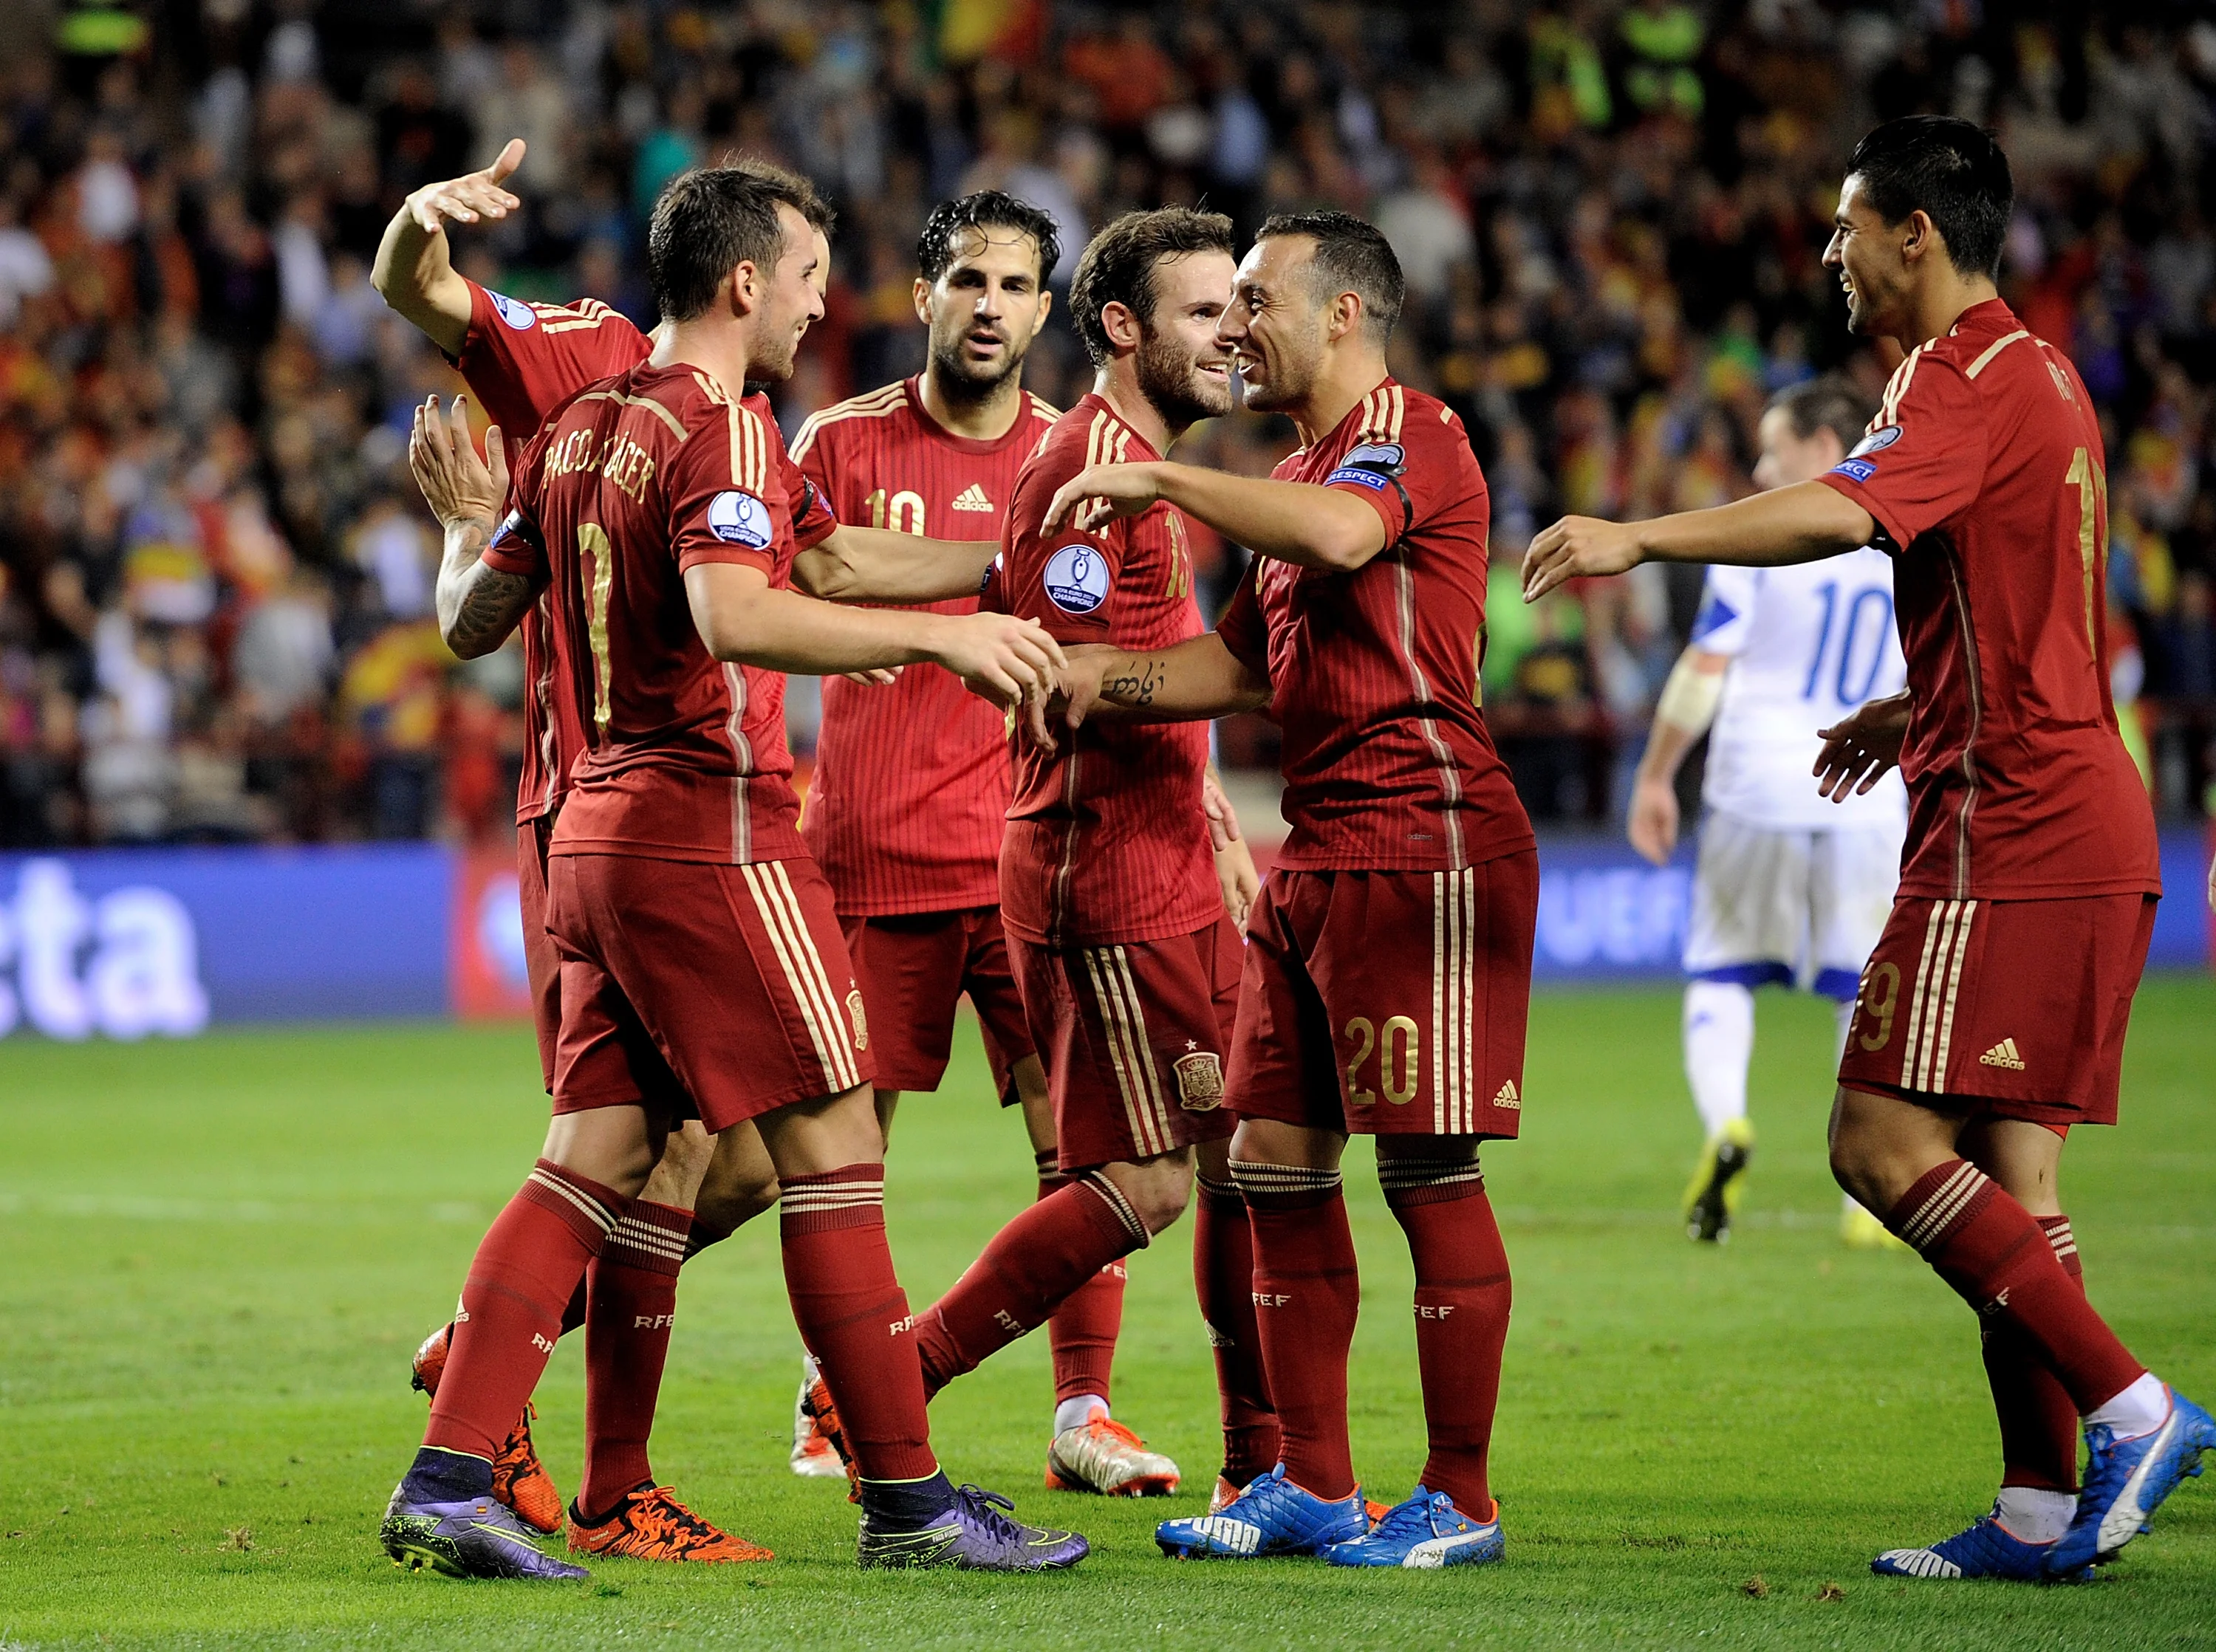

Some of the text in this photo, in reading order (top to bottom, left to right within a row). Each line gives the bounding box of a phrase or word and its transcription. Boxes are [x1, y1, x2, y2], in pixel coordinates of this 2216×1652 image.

[543, 429, 593, 489] PACO
[1330, 470, 1386, 487] RESPECT
[865, 488, 925, 537] 10
[951, 500, 994, 513] adidas
[1800, 582, 1893, 705] 10
[0, 857, 209, 1040] ta
[1344, 1015, 1419, 1105] 20
[1979, 1053, 2025, 1071] adidas
[1493, 1097, 1520, 1110] adidas
